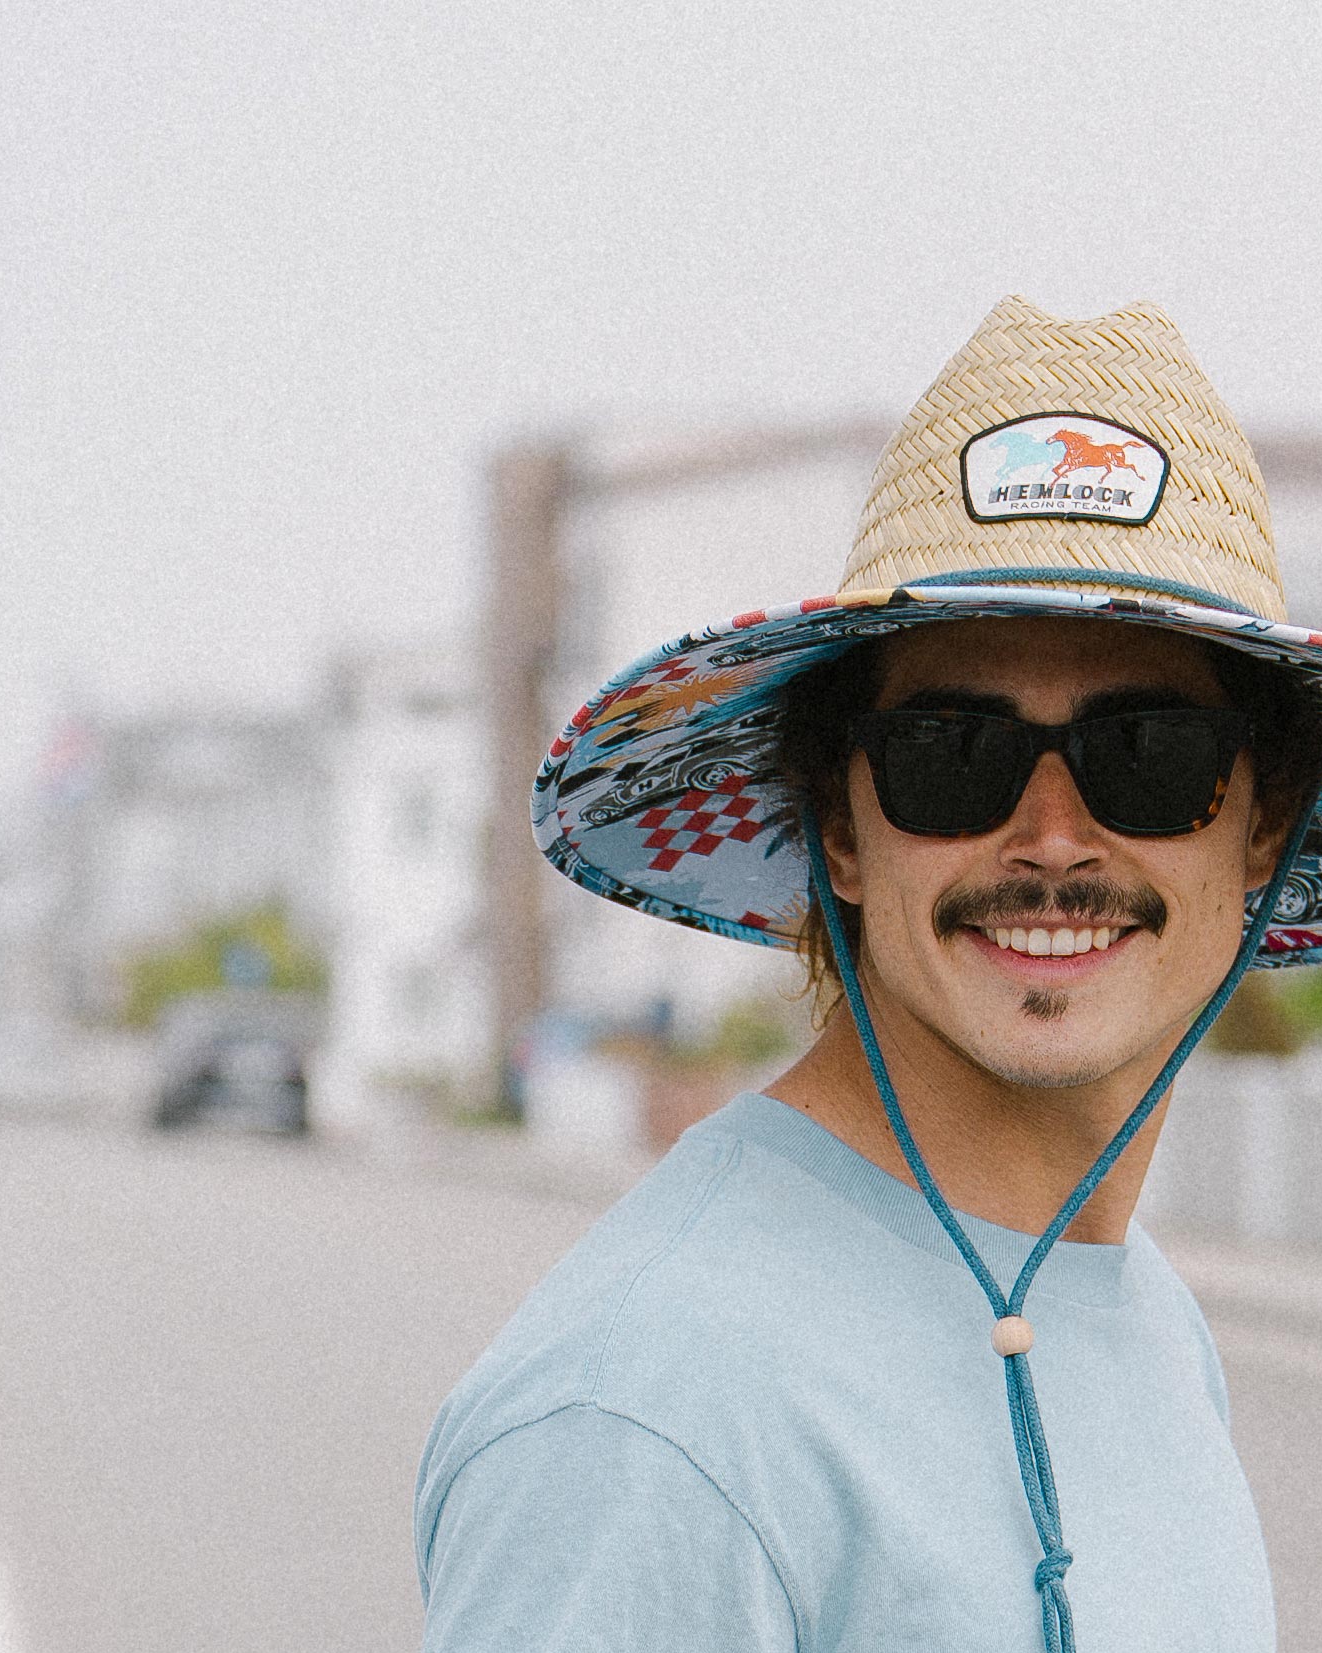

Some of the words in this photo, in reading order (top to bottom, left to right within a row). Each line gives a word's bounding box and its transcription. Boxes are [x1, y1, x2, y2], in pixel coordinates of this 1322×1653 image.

[988, 484, 1135, 507] HEMLOCK
[1010, 500, 1065, 510] RACING
[1072, 501, 1112, 513] TEAM
